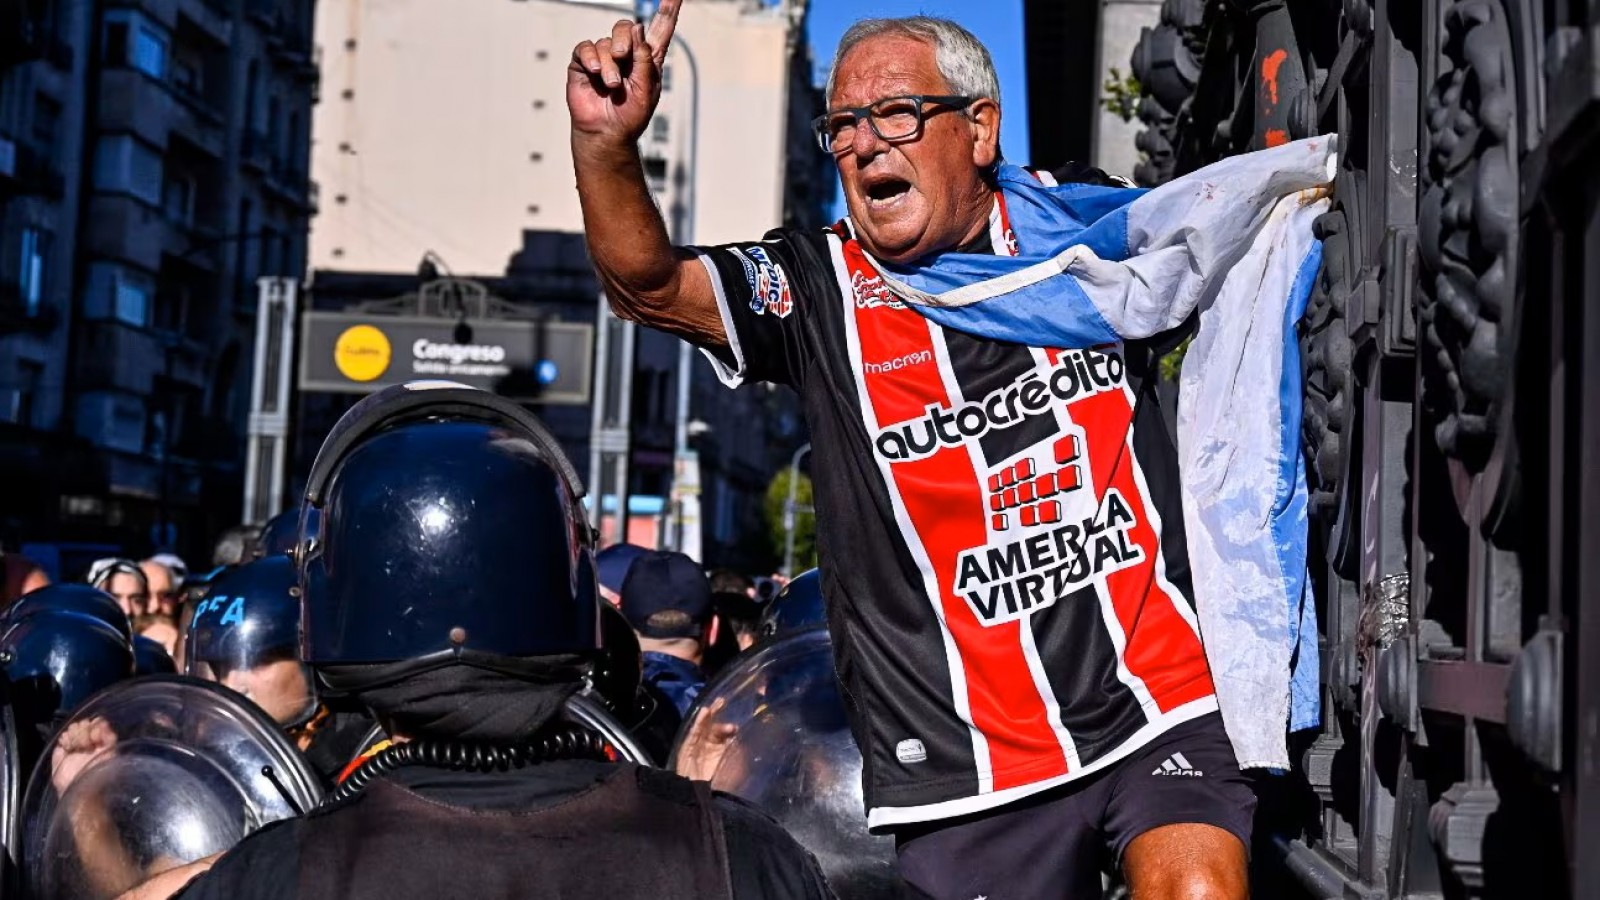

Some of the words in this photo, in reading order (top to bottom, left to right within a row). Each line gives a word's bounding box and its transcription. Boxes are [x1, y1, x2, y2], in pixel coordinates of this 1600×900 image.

[413, 338, 506, 365] Congreso
[865, 350, 931, 374] macron
[876, 348, 1124, 459] autocrédito
[967, 529, 1140, 620] VIRTUAL
[192, 595, 246, 629] PFA
